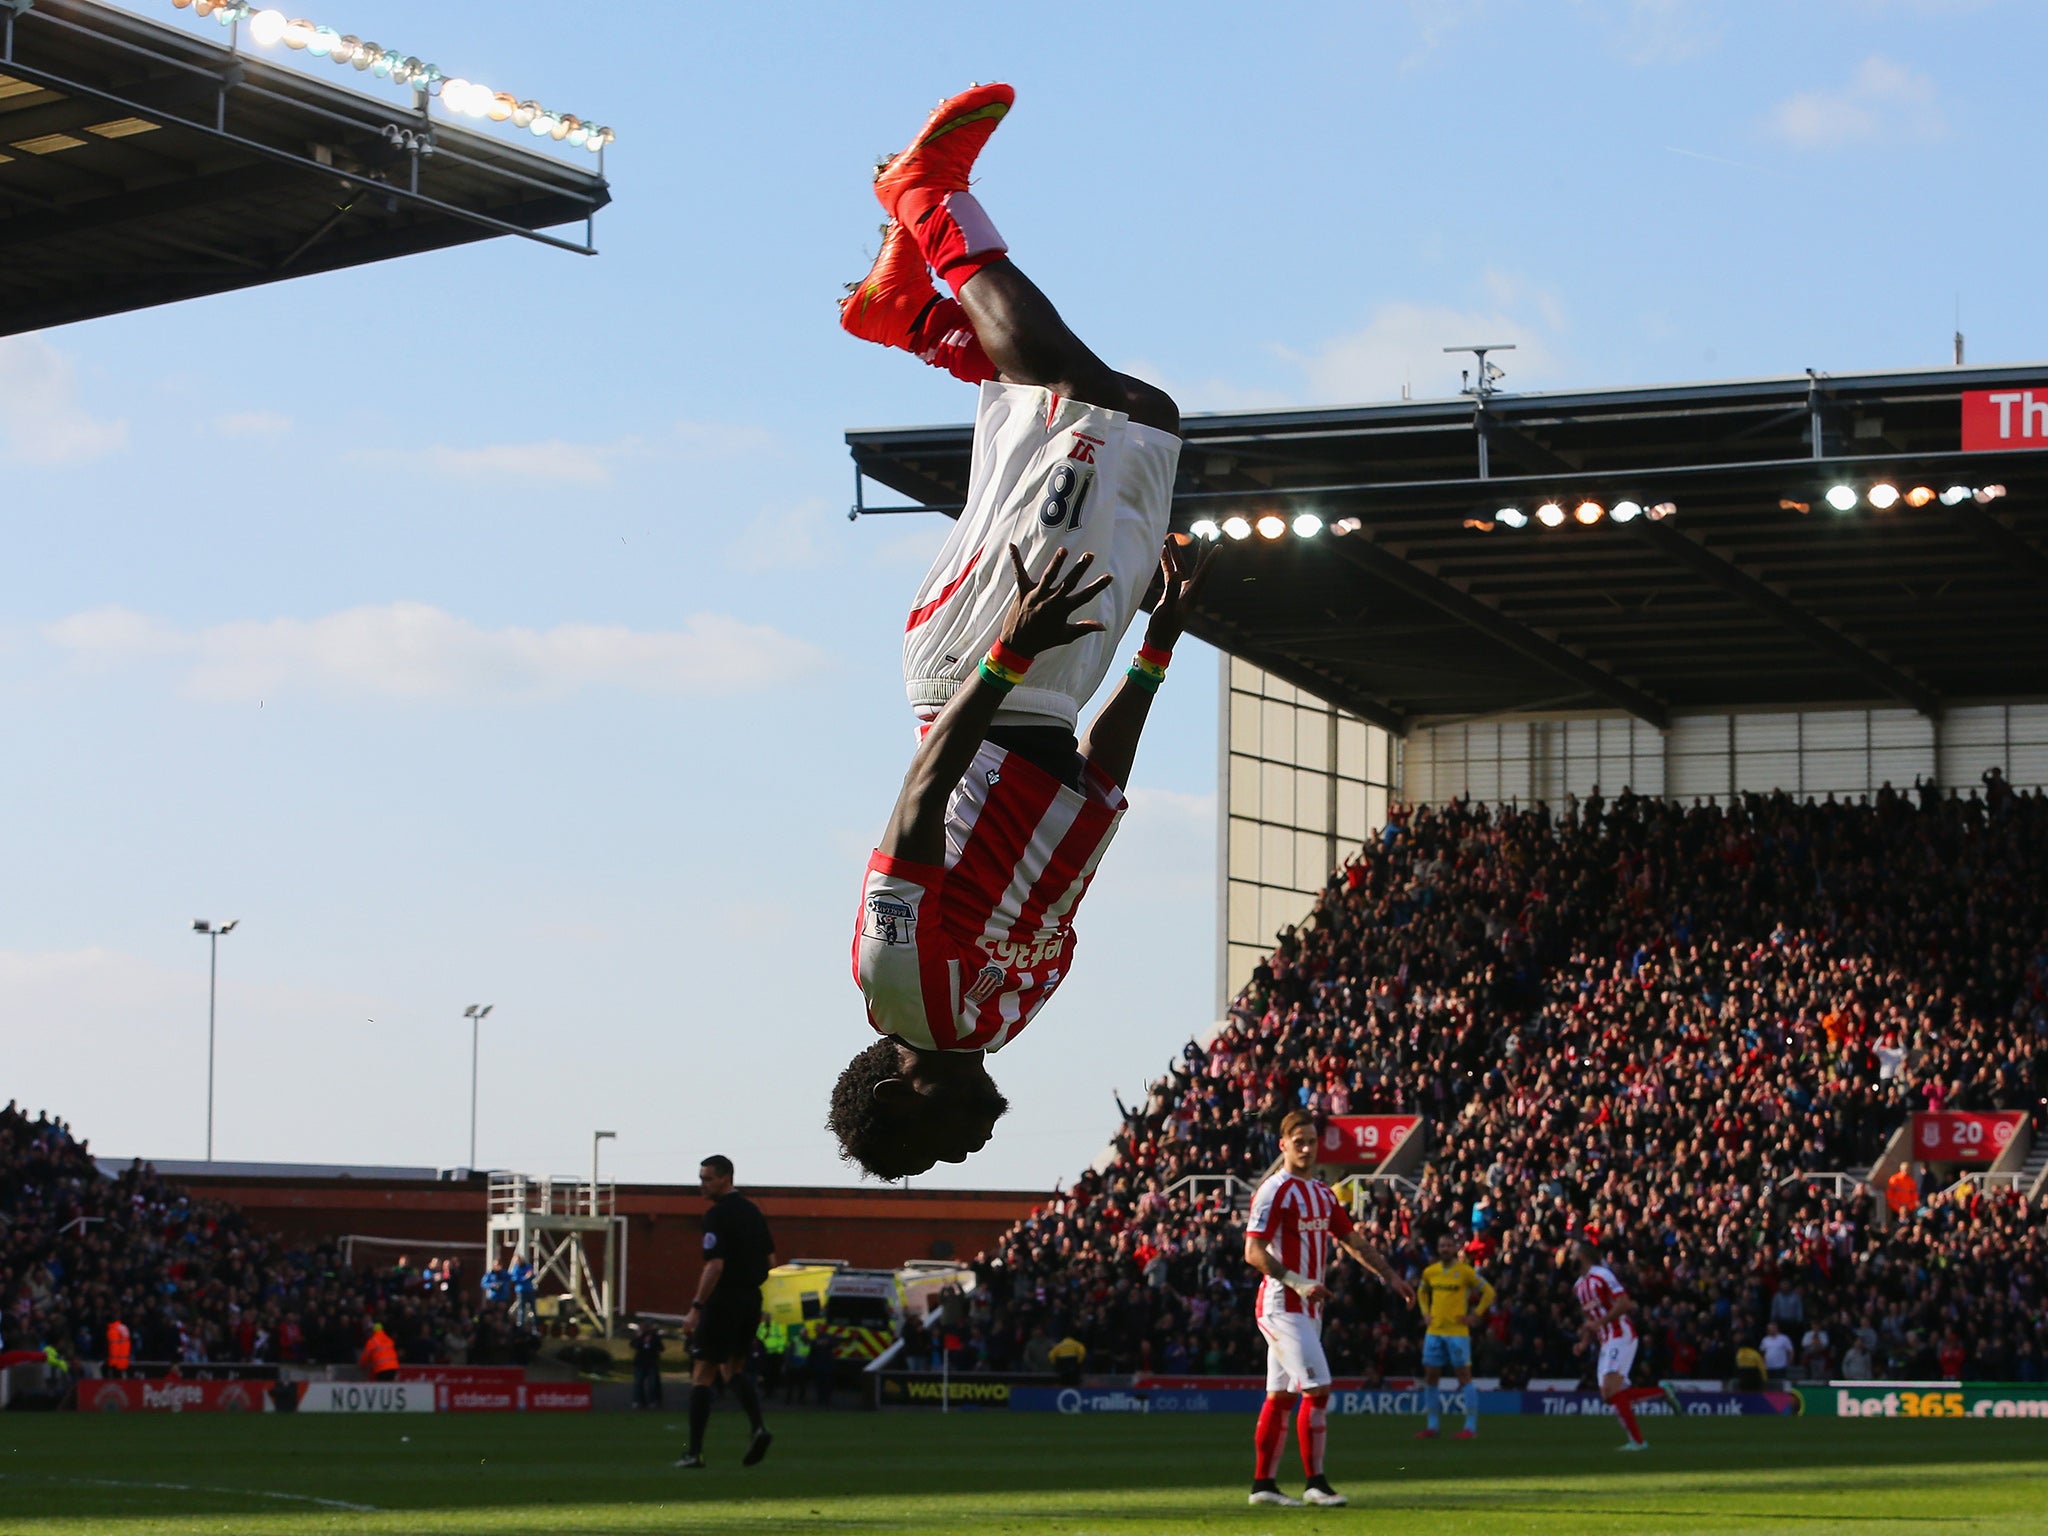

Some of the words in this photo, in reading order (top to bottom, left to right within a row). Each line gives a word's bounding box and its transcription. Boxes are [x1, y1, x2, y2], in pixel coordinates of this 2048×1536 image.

[1989, 391, 2048, 439] Th
[1039, 462, 1096, 532] 18
[1353, 1124, 1379, 1148] 19
[1952, 1120, 1983, 1145] 20
[331, 1387, 407, 1411] NOVUS
[1342, 1392, 1469, 1415] BARCLYS
[1542, 1397, 1573, 1416] Tile
